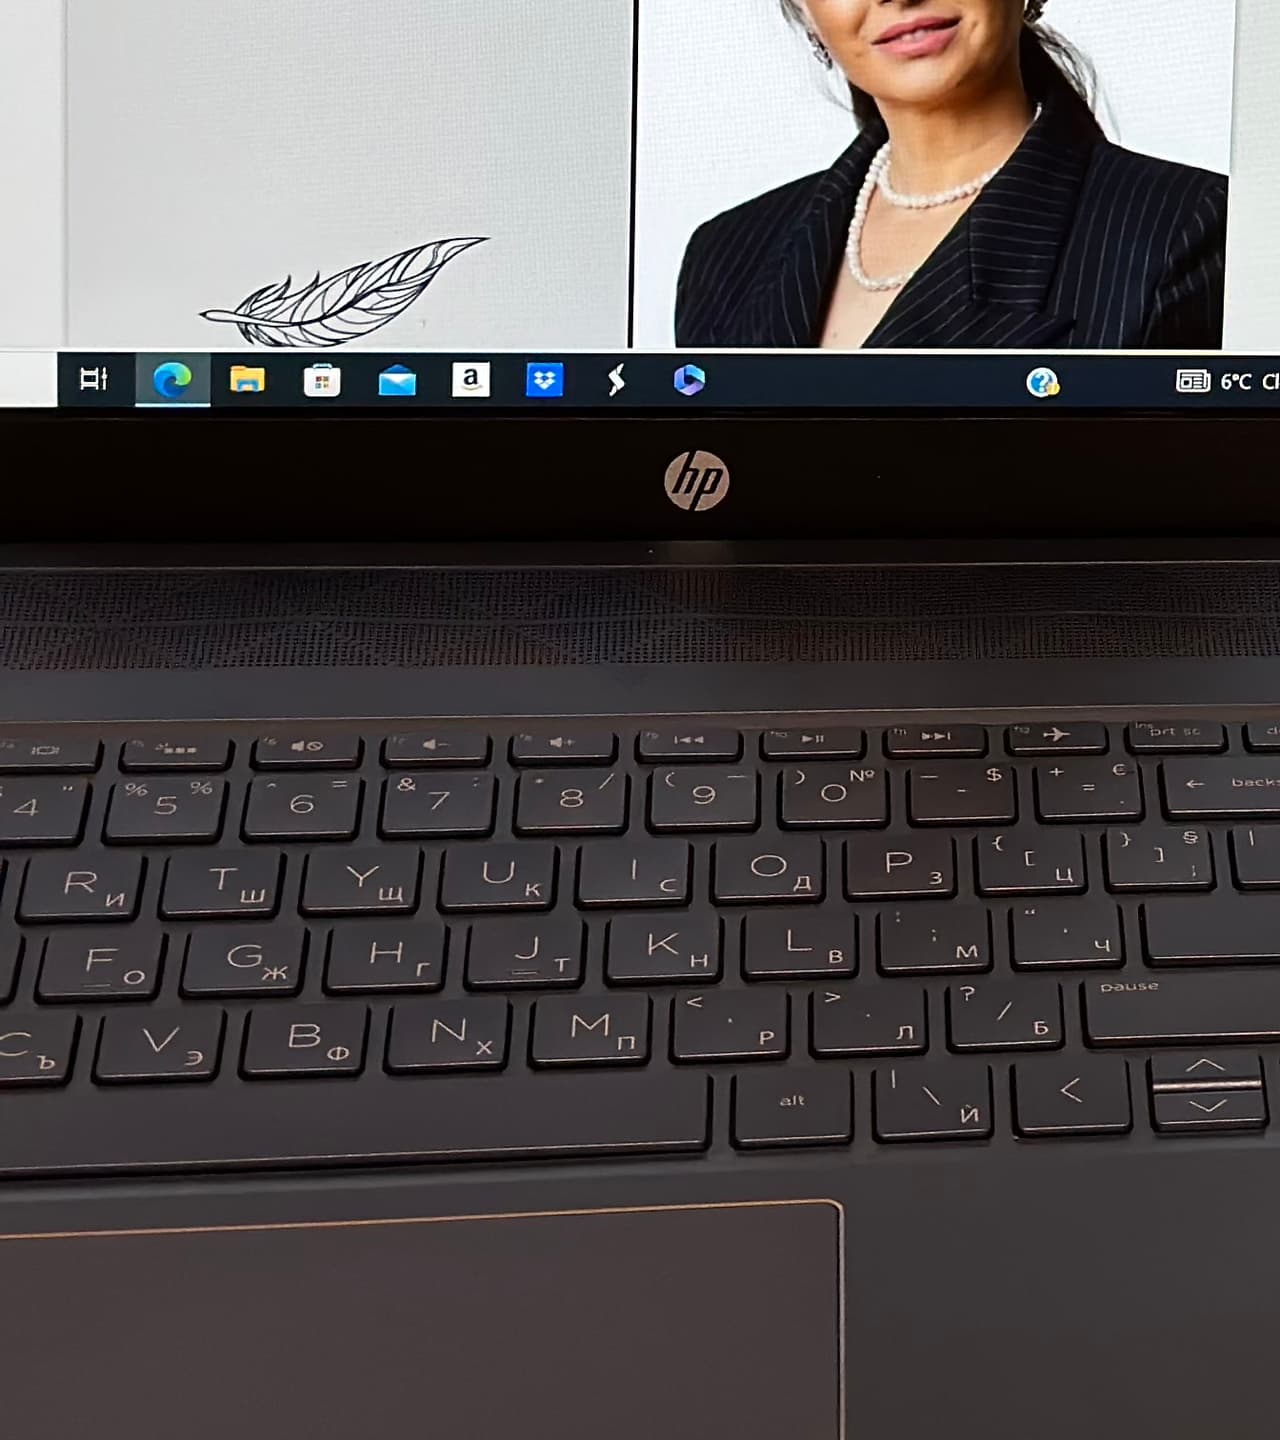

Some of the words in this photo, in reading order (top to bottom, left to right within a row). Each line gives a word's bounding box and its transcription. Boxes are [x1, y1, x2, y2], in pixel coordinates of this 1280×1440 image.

[665, 450, 730, 511] hp
[154, 795, 177, 815] 5
[290, 794, 314, 814] 6
[429, 791, 450, 811] 7
[559, 788, 584, 808] 8
[692, 785, 716, 804] 9
[13, 798, 39, 816] 4
[483, 861, 515, 884] U
[885, 852, 913, 874] P
[64, 871, 98, 894] R
[209, 868, 238, 891] T
[346, 865, 380, 888] Y
[86, 948, 119, 972] F
[227, 944, 263, 968] G
[369, 941, 403, 963] H
[1100, 980, 1160, 993] pause
[571, 1013, 610, 1038] M
[780, 1094, 805, 1107] alt
